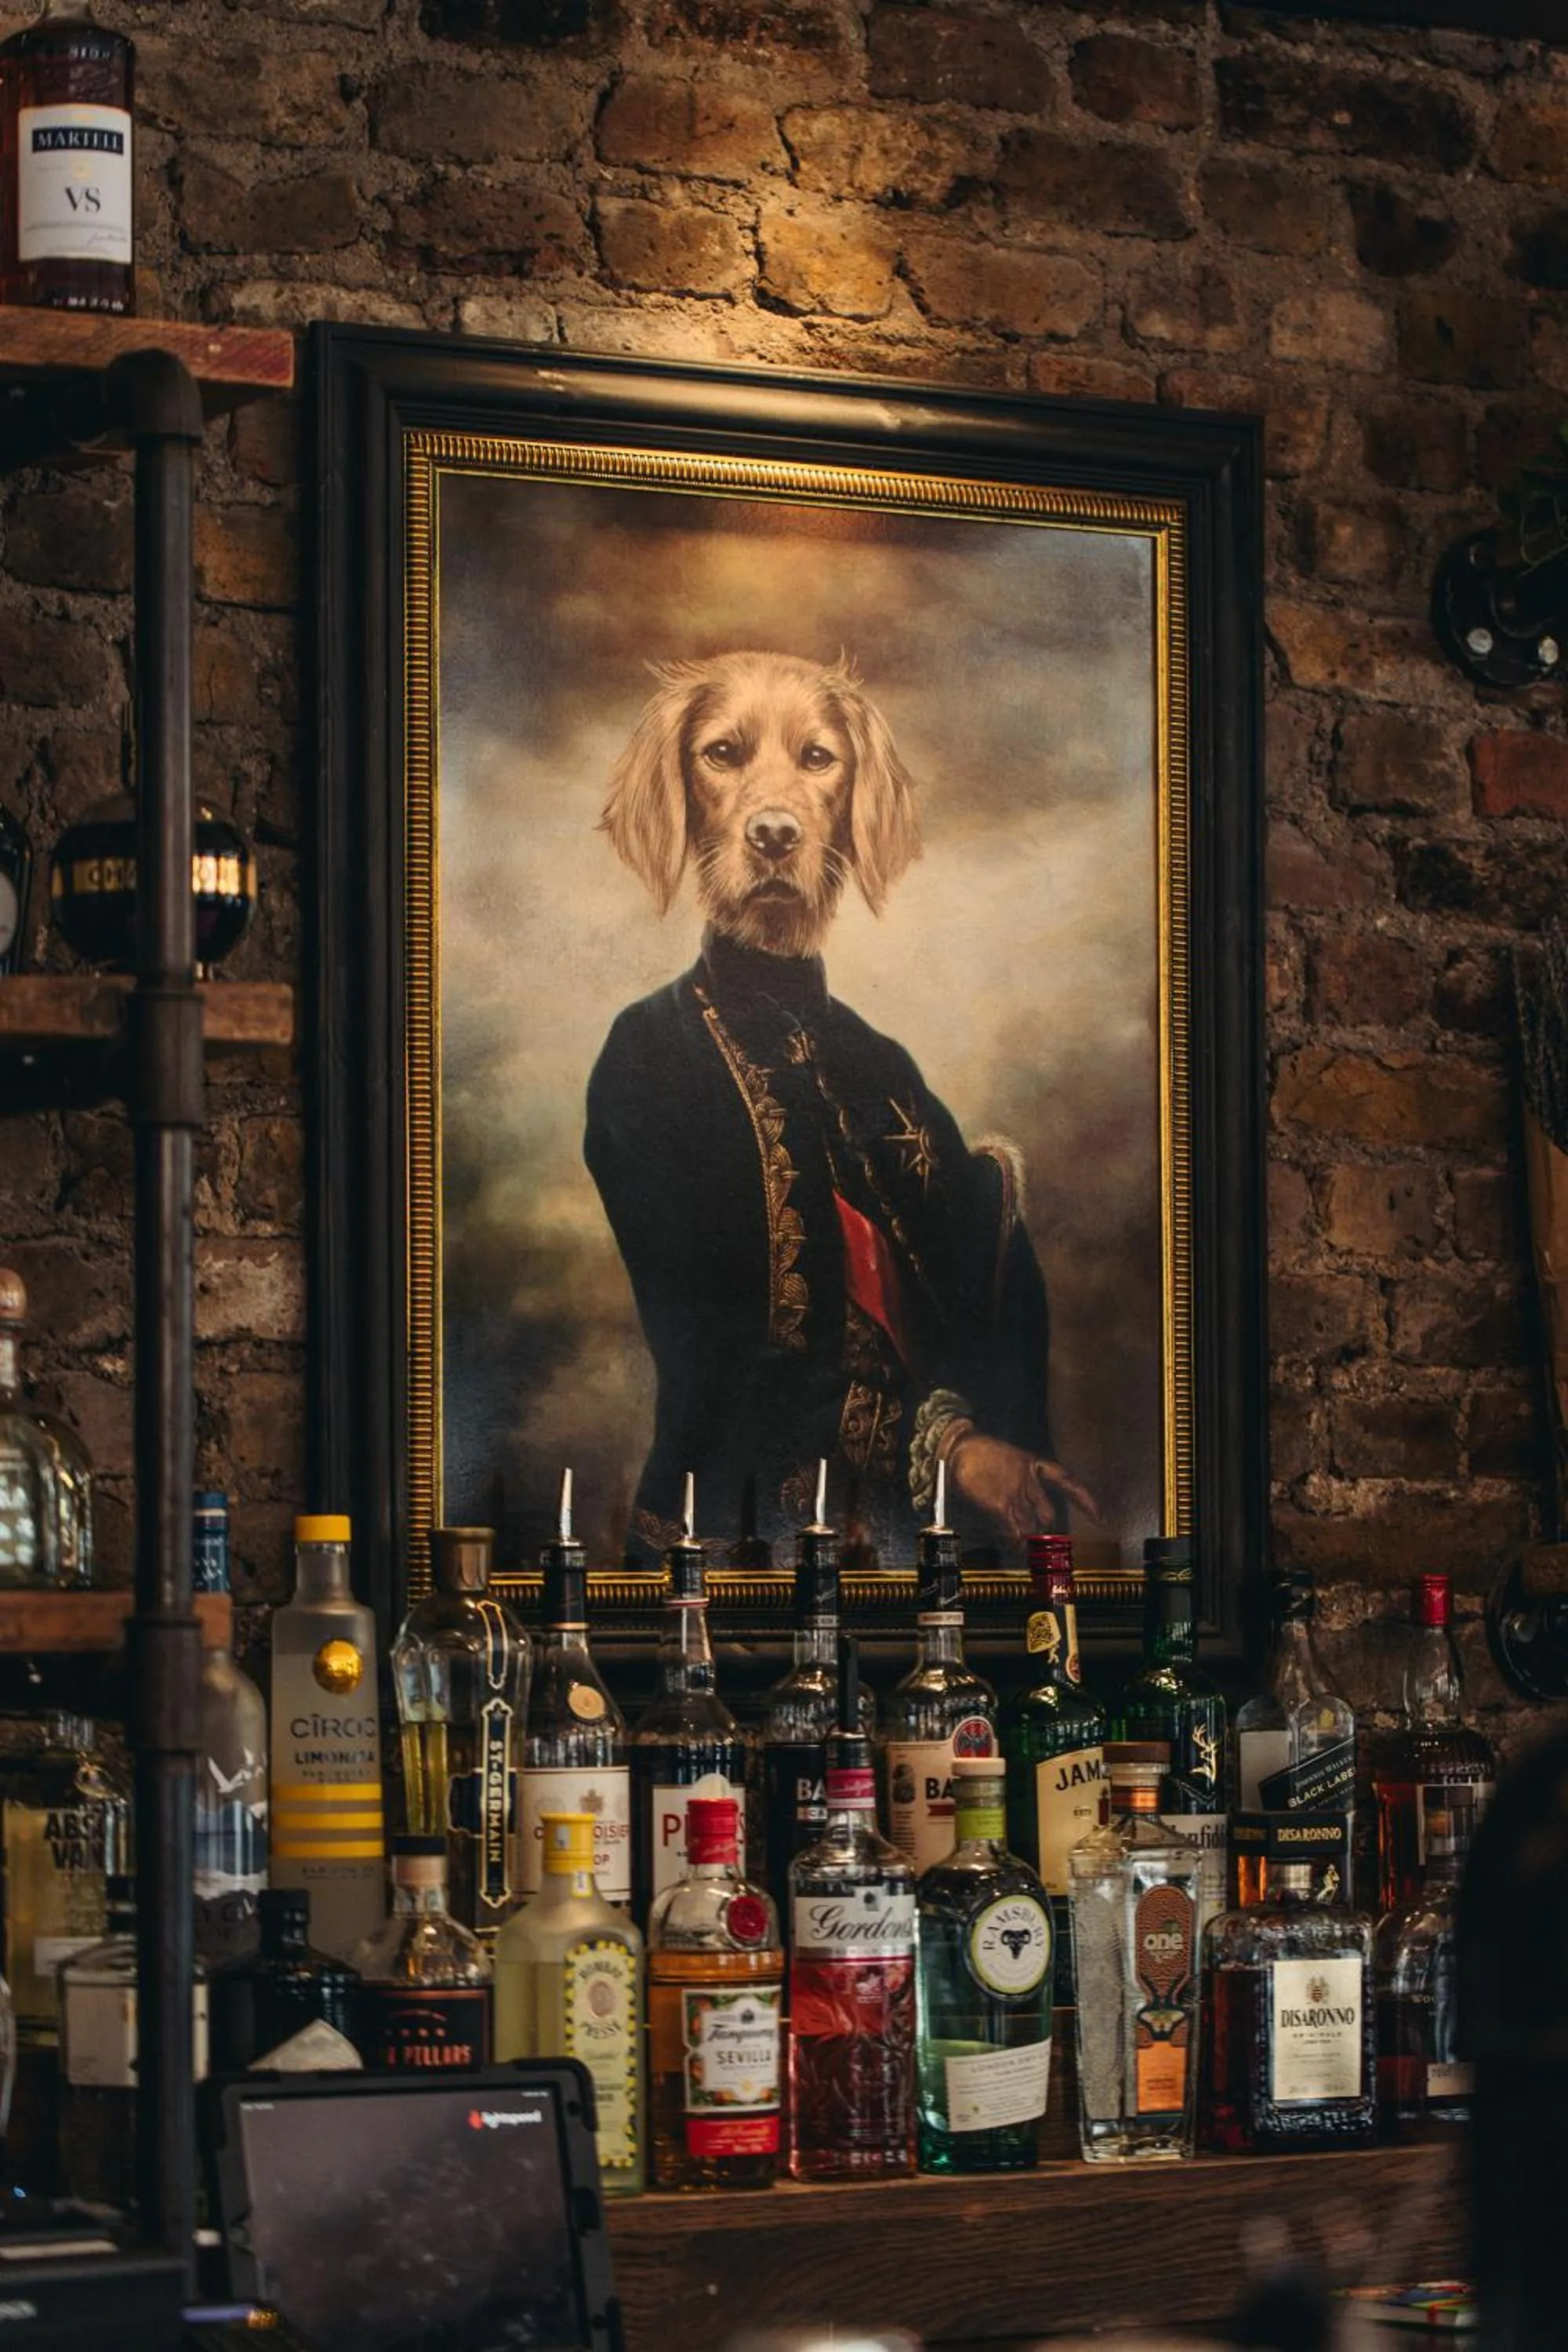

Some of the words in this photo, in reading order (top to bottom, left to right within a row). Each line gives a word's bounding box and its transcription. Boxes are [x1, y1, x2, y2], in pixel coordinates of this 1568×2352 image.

[64, 187, 101, 212] VS
[1287, 1784, 1325, 1808] BLACK
[1280, 2007, 1355, 2028] DISARONNO
